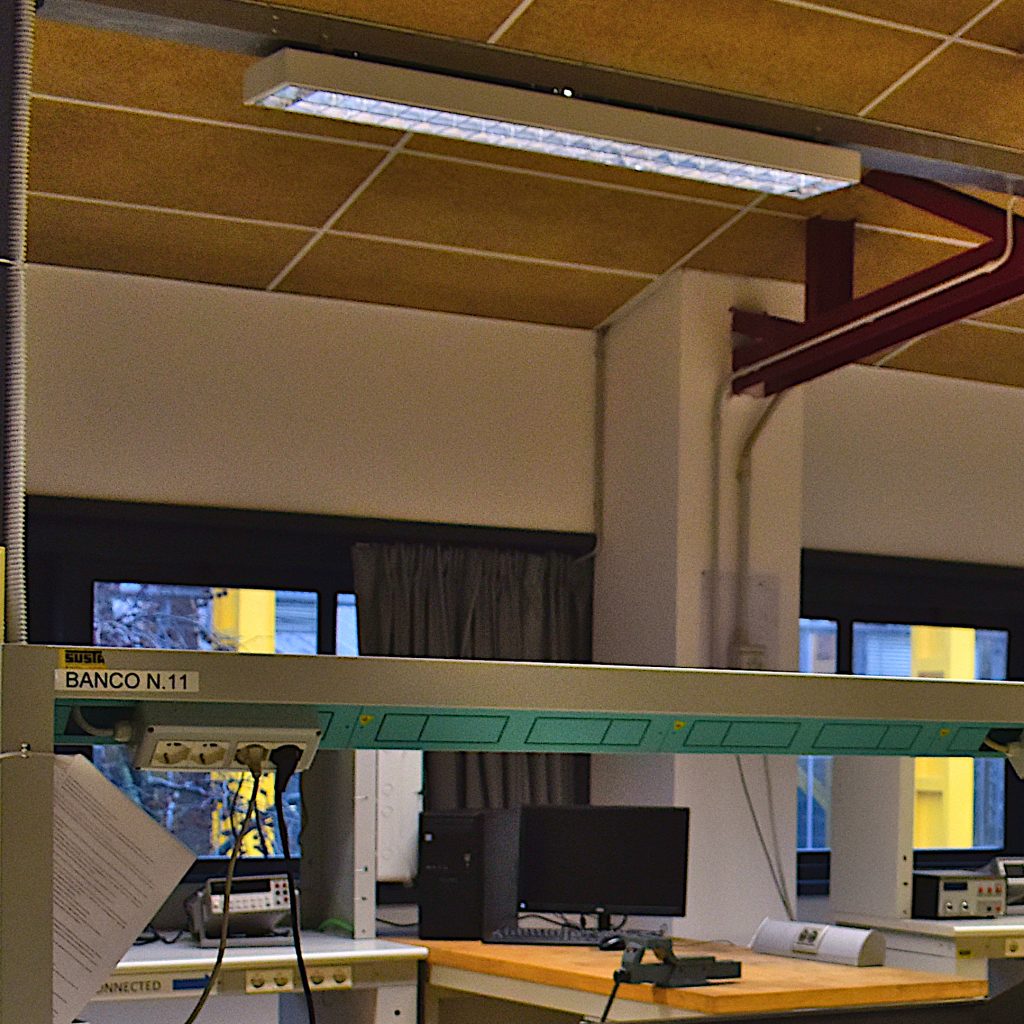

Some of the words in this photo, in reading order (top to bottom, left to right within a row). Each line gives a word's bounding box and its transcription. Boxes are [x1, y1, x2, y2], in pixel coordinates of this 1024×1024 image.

[65, 671, 140, 689] BANCO
[146, 673, 187, 690] N.11
[97, 980, 161, 994] NNECTED
